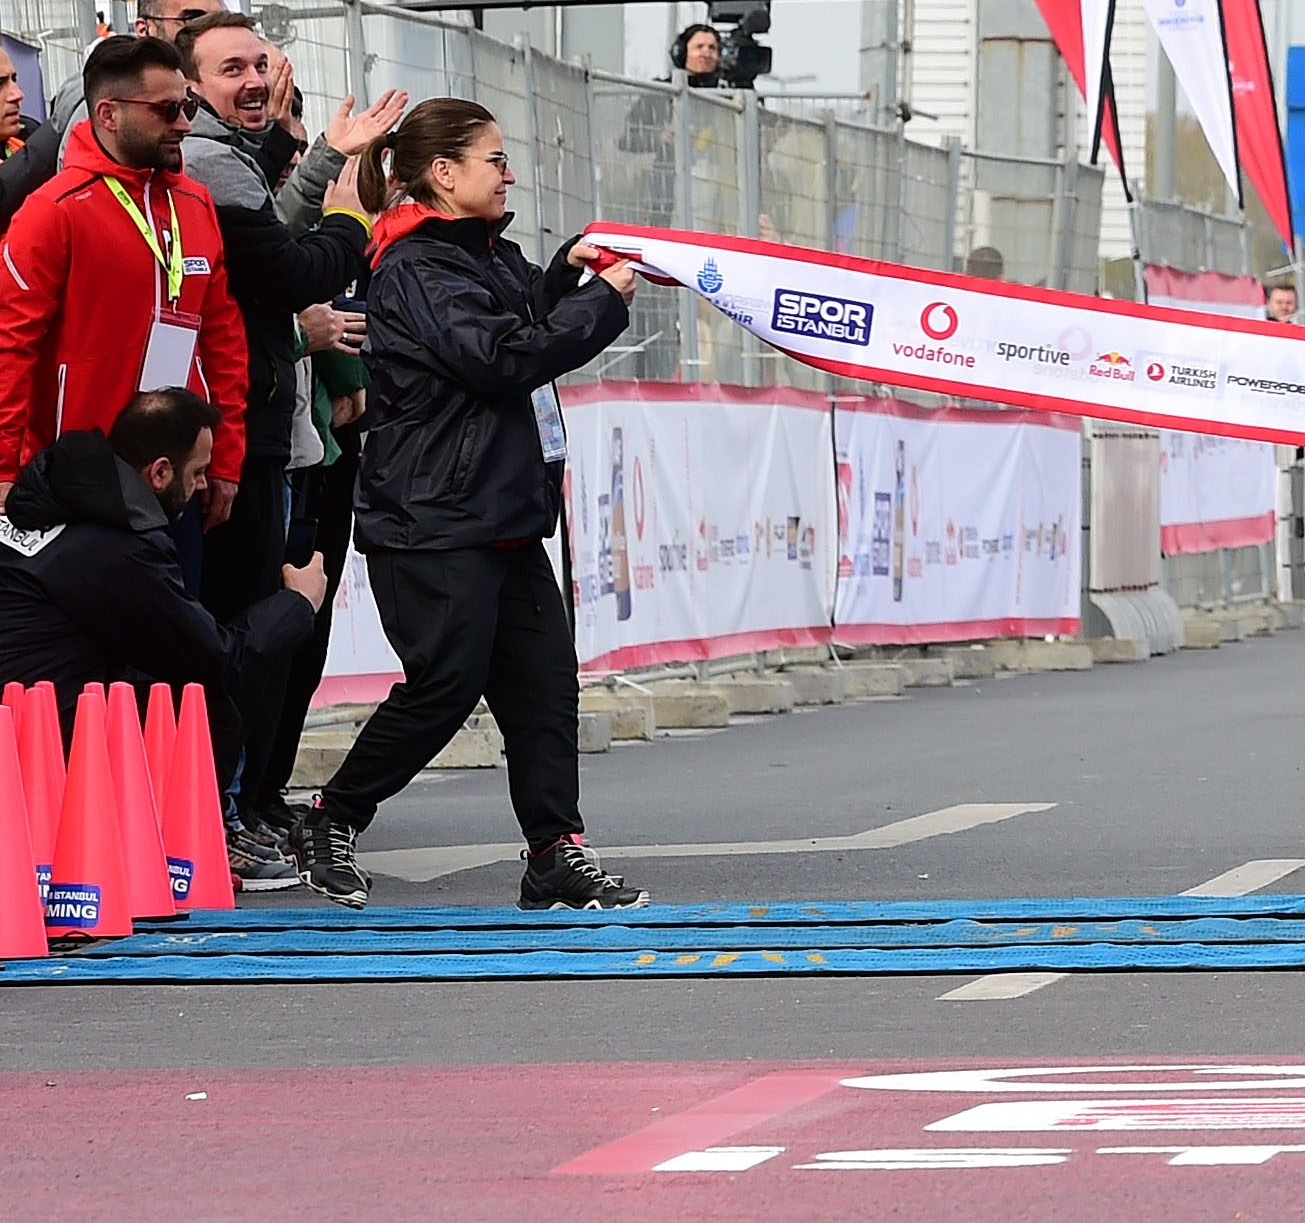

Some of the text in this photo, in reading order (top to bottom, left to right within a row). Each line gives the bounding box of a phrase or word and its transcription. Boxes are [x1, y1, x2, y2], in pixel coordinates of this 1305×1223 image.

[779, 292, 867, 327] SPOR
[892, 341, 976, 368] vodafone
[996, 341, 1070, 366] sportive
[1089, 364, 1135, 382] Red Bull
[1170, 365, 1218, 379] TURKISH
[1168, 376, 1217, 390] AIRLINES
